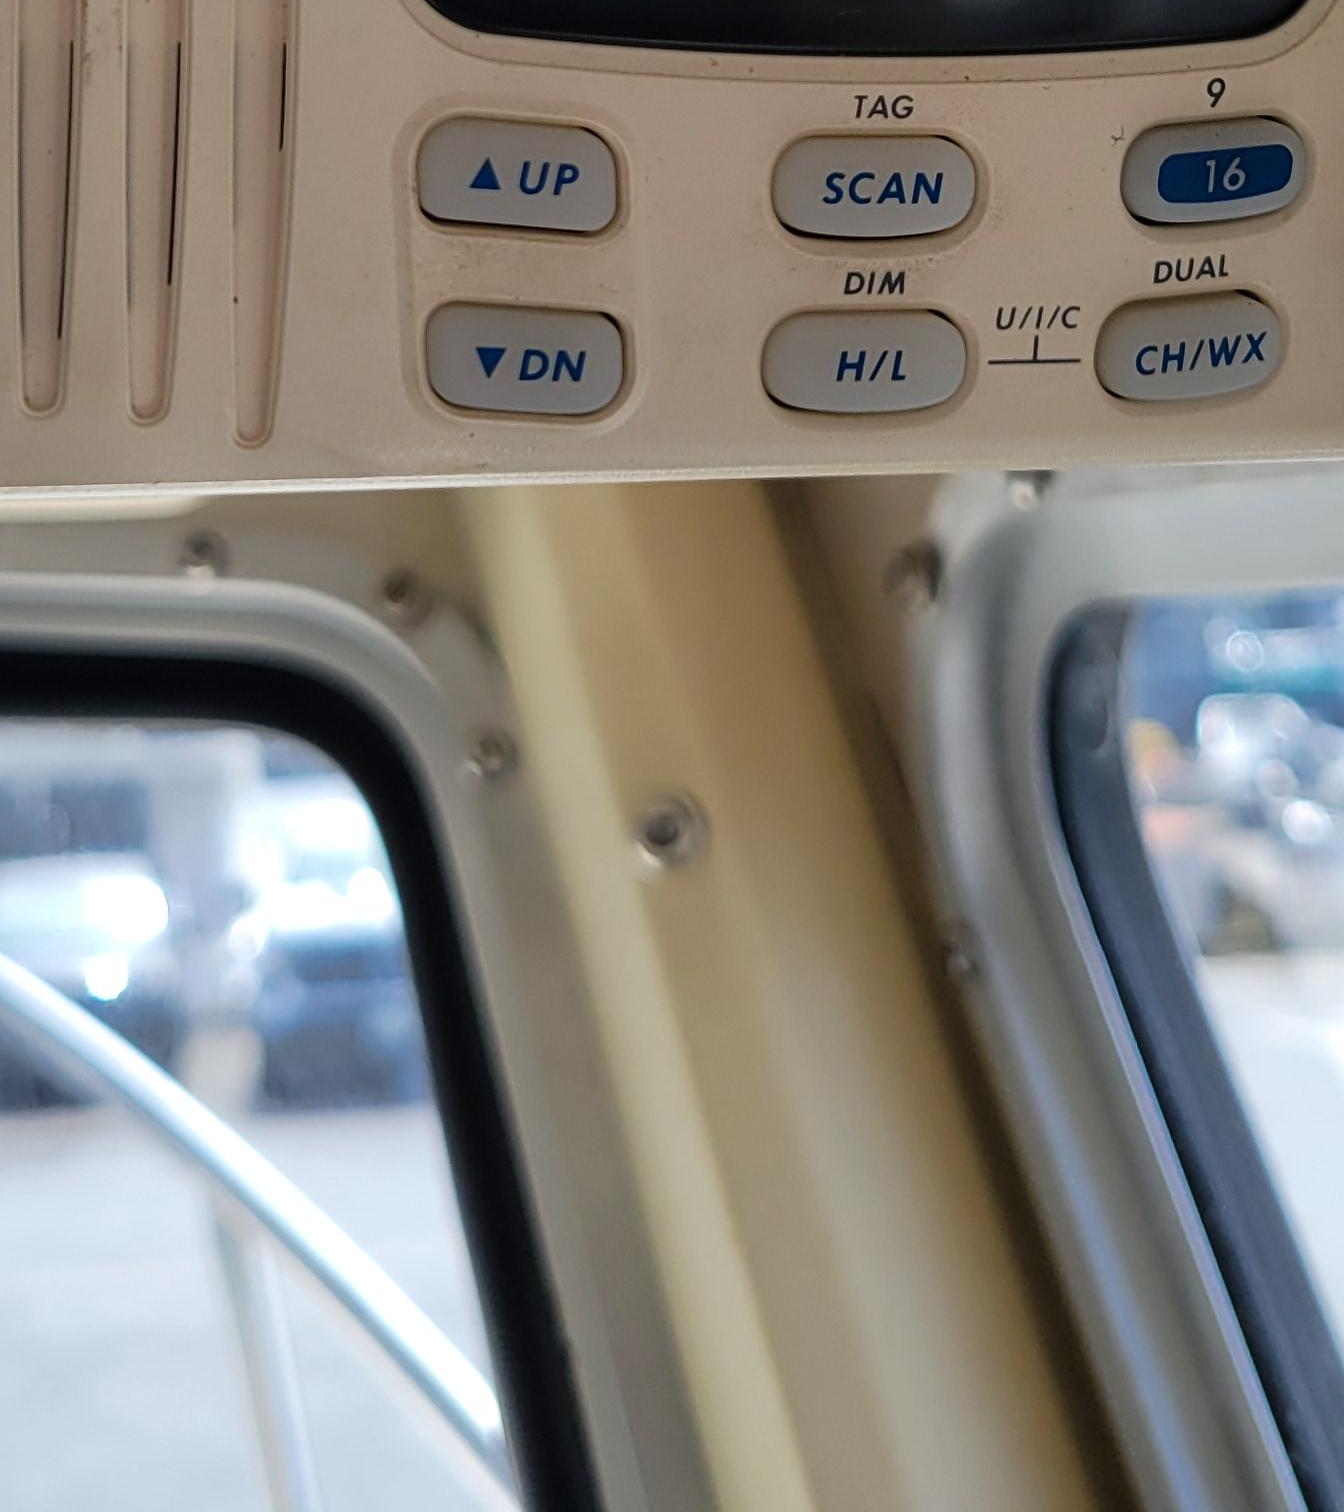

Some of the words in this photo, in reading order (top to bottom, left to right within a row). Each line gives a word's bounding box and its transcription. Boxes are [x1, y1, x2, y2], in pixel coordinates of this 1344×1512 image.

[854, 94, 915, 120] TAG
[1206, 77, 1227, 108] 9
[517, 161, 581, 196] UP
[821, 171, 944, 205] SCAN
[1204, 157, 1246, 192] 16
[843, 271, 906, 296] DIM
[1152, 254, 1229, 284] DUAL
[518, 349, 587, 383] DN
[836, 350, 908, 382] H/L
[1136, 331, 1268, 376] CH/WX
